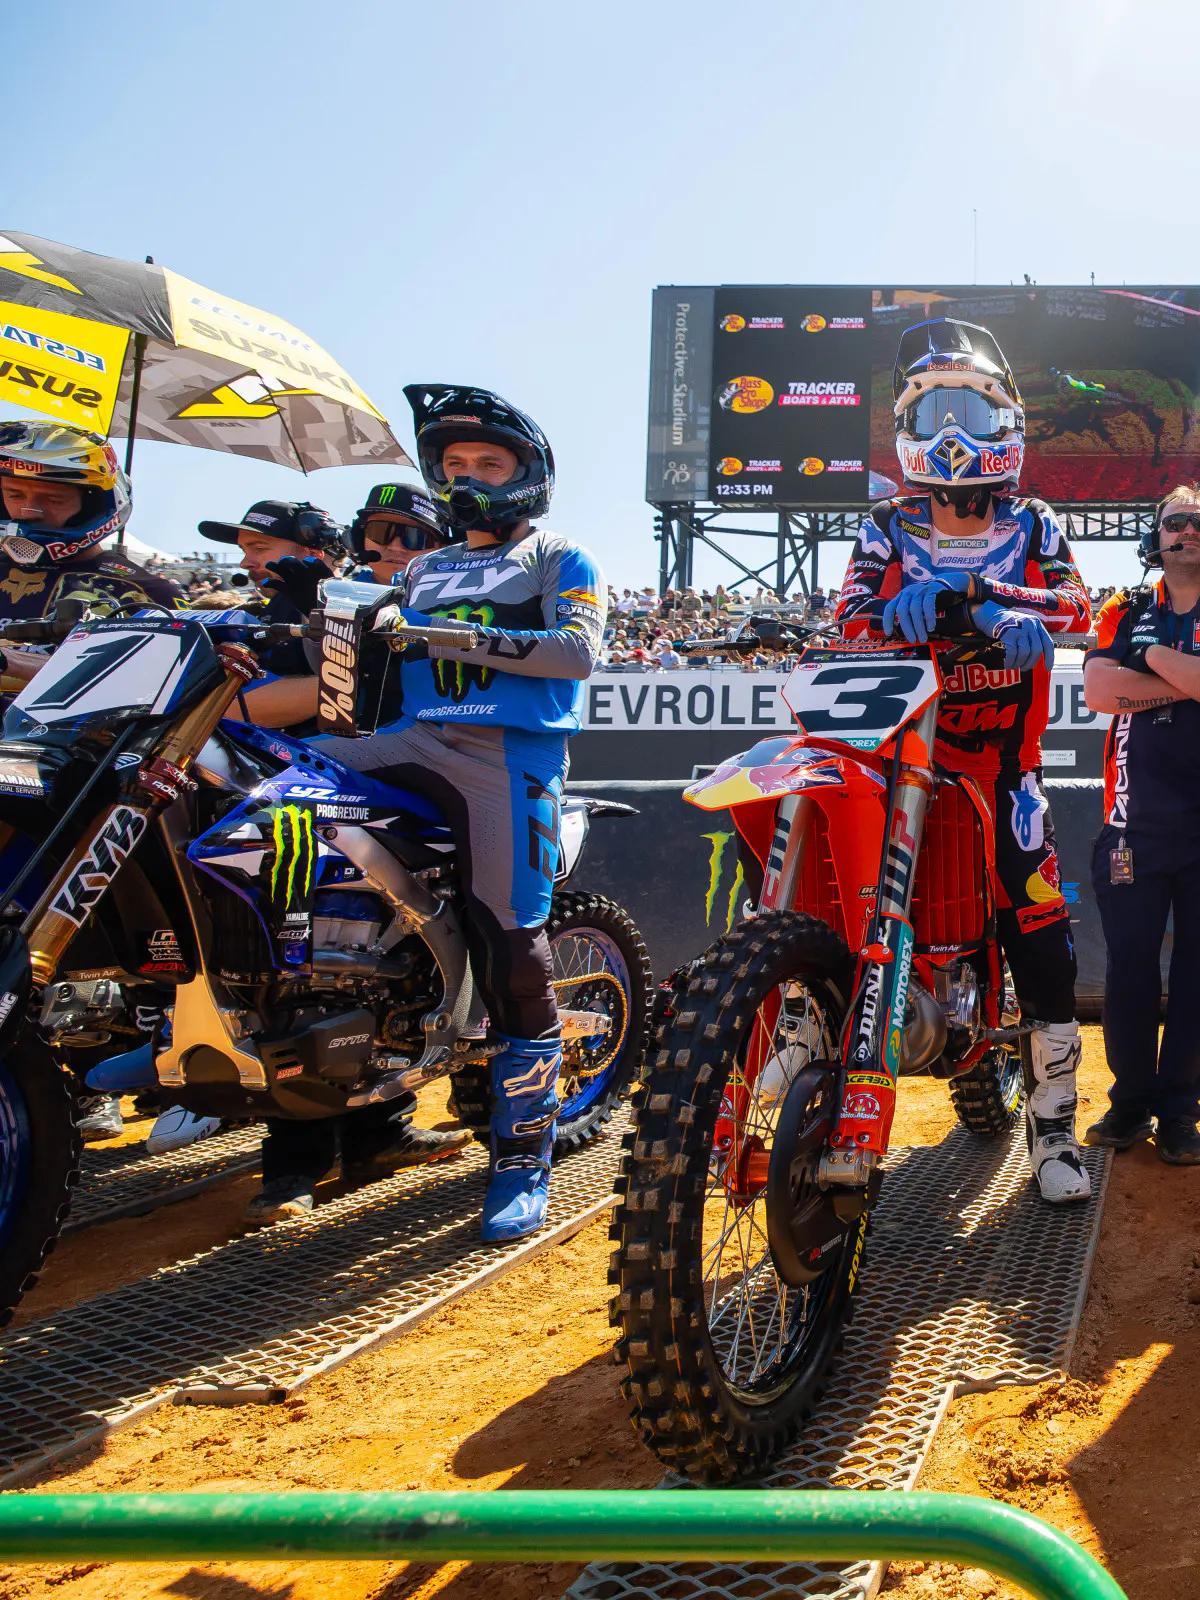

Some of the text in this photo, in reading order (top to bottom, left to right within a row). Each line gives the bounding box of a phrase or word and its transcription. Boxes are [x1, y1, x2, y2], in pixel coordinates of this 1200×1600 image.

[189, 318, 353, 393] SUZUKI
[927, 362, 975, 372] Red Bull
[671, 302, 691, 446] Protective Stadium
[738, 377, 762, 389] Bass
[788, 382, 855, 395] TRACKER
[740, 388, 757, 399] Pro
[738, 396, 768, 409] Shops
[782, 396, 856, 405] BOATS & ATVs
[902, 446, 927, 473] Bull
[979, 444, 1012, 474] Red
[15, 460, 43, 473] Bull
[716, 484, 773, 495] 12:33 PM
[949, 540, 986, 548] MOTOREX
[454, 556, 503, 571] YAMAHA
[937, 555, 988, 566] PROGRESSIVE
[409, 566, 525, 607] FLY
[1132, 625, 1156, 634] WP
[967, 664, 1021, 692] Bull
[588, 684, 790, 725] EVROLE
[796, 665, 925, 732] 3
[417, 704, 498, 720] PROGRESSIVE
[847, 739, 878, 748] TOREX
[0, 774, 44, 788] AMAHA
[15, 787, 46, 796] SERVICES
[284, 785, 368, 803] YZ 450F
[316, 803, 370, 821] PROGRESSIVE
[1121, 852, 1130, 862] L3
[79, 968, 117, 980] Twin Air
[892, 936, 913, 1029] MOTOREX
[328, 1033, 371, 1049] GYTR
